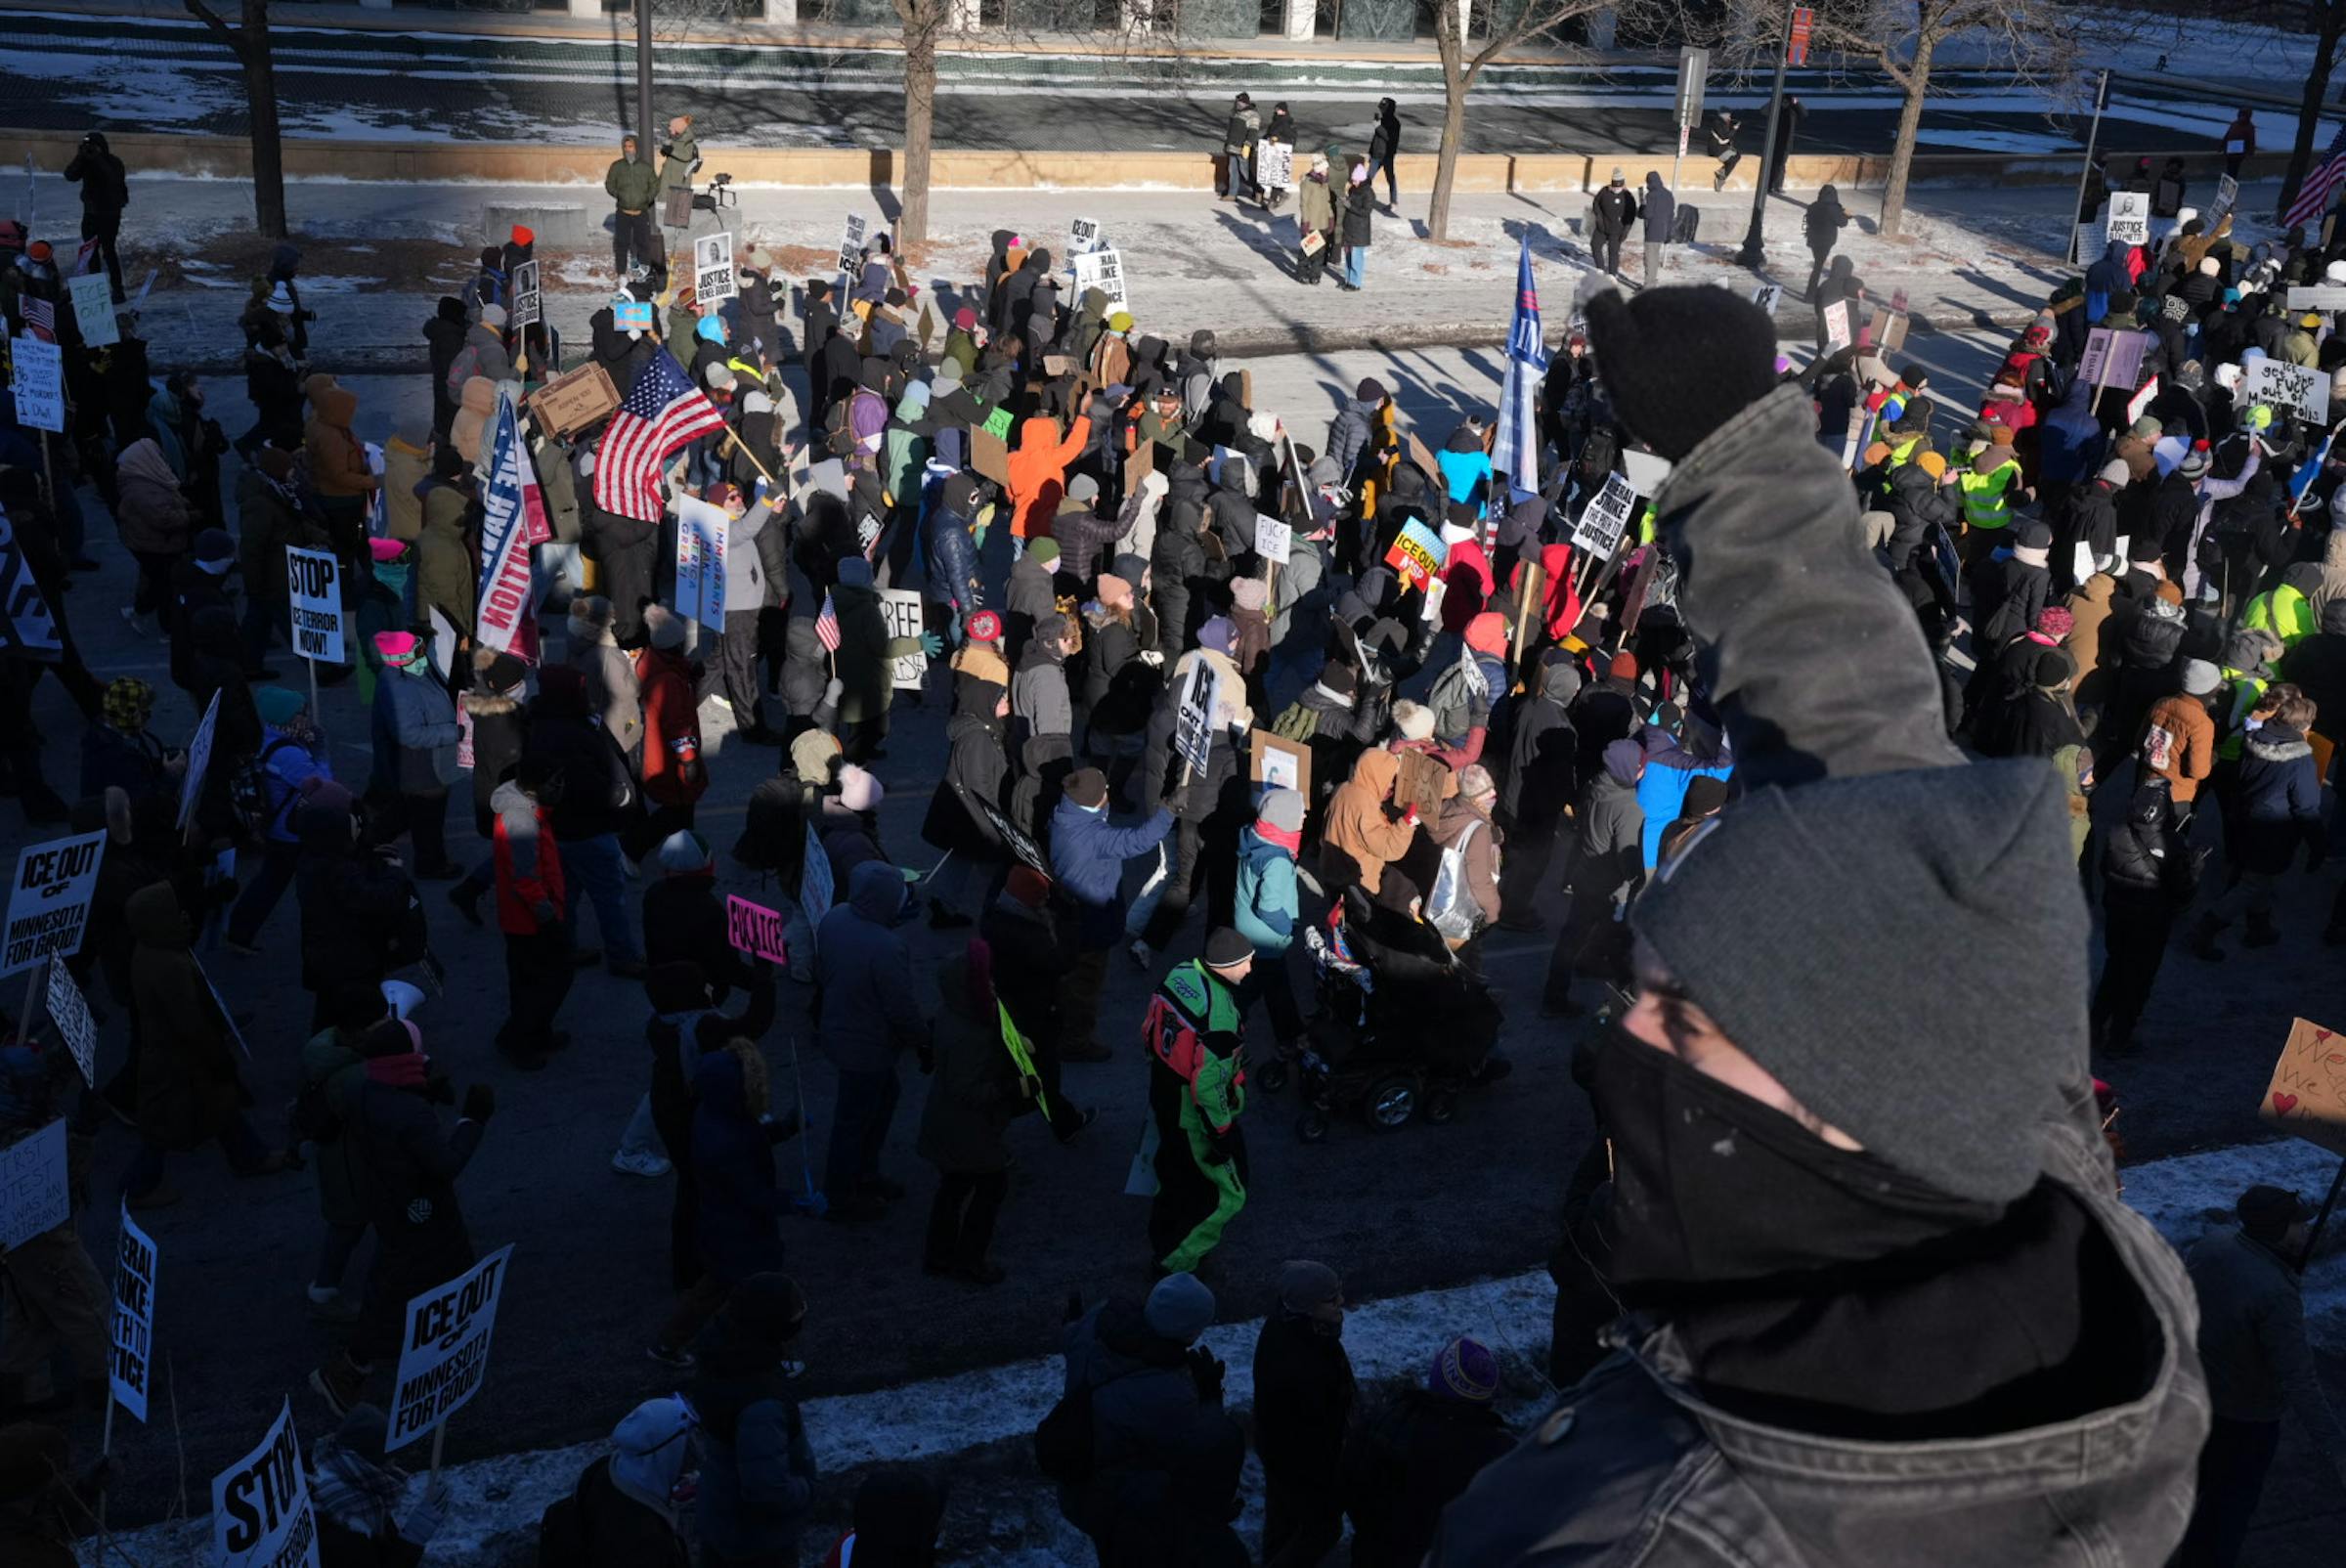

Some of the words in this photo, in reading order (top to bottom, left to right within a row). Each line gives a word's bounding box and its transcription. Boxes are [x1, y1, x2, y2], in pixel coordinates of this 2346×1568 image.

[2110, 220, 2144, 234] JUSTICE
[699, 269, 730, 288] JUSTICE
[17, 383, 26, 398] 2
[2261, 367, 2285, 379] get
[2294, 373, 2315, 386] the
[2261, 386, 2284, 401] out
[2290, 393, 2303, 405] of
[1261, 539, 1280, 554] ICE
[1580, 522, 1615, 552] JUSTICE
[688, 522, 701, 599] AMERICA
[1397, 534, 1420, 557] ICE
[1418, 550, 1438, 574] OUT
[1399, 555, 1424, 579] MSP
[289, 552, 334, 599] STOP
[712, 525, 724, 617] IMMIGRANTS
[302, 610, 338, 632] TERROR
[21, 850, 58, 890] ICE
[57, 841, 100, 881] OUT
[42, 882, 69, 898] OF
[9, 903, 85, 942] MINNESOTA
[4, 938, 34, 969] FOR
[411, 1289, 457, 1351] ICE
[456, 1258, 501, 1325] OUT
[136, 1320, 148, 1359] TO
[439, 1320, 471, 1351] OF
[400, 1328, 488, 1409] MINNESOTA
[394, 1392, 437, 1438] FOR
[225, 1416, 297, 1553] STOP
